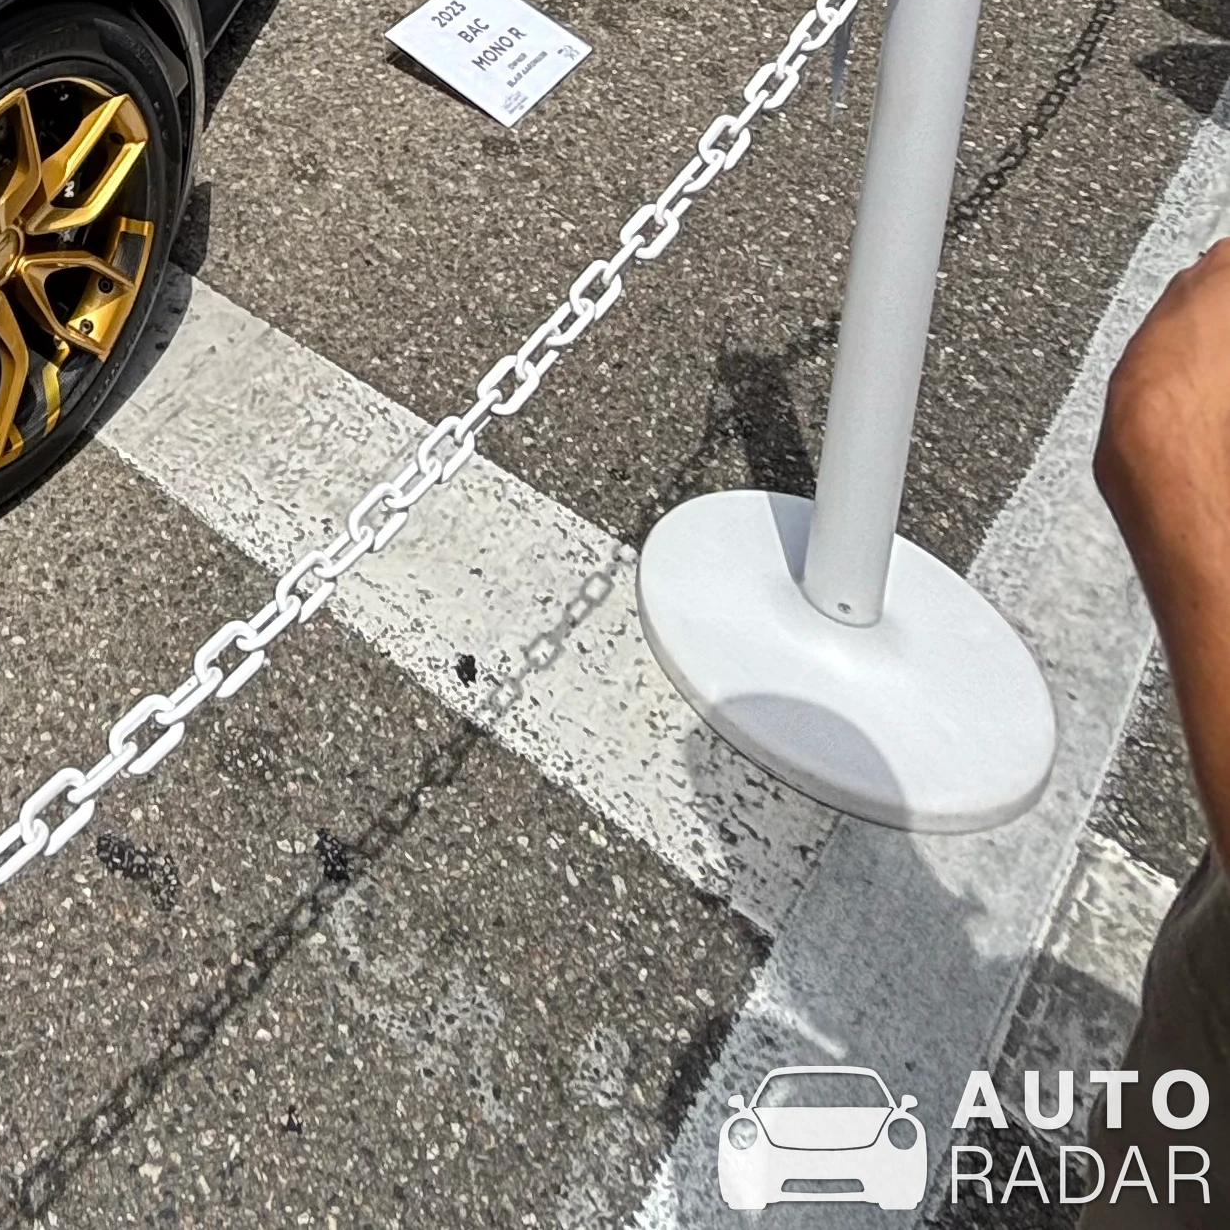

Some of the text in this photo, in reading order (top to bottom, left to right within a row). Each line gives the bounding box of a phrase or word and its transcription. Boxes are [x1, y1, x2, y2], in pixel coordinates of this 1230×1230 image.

[431, 0, 467, 28] 2023
[457, 18, 490, 43] BAC
[471, 36, 514, 72] MONO
[507, 27, 528, 40] R
